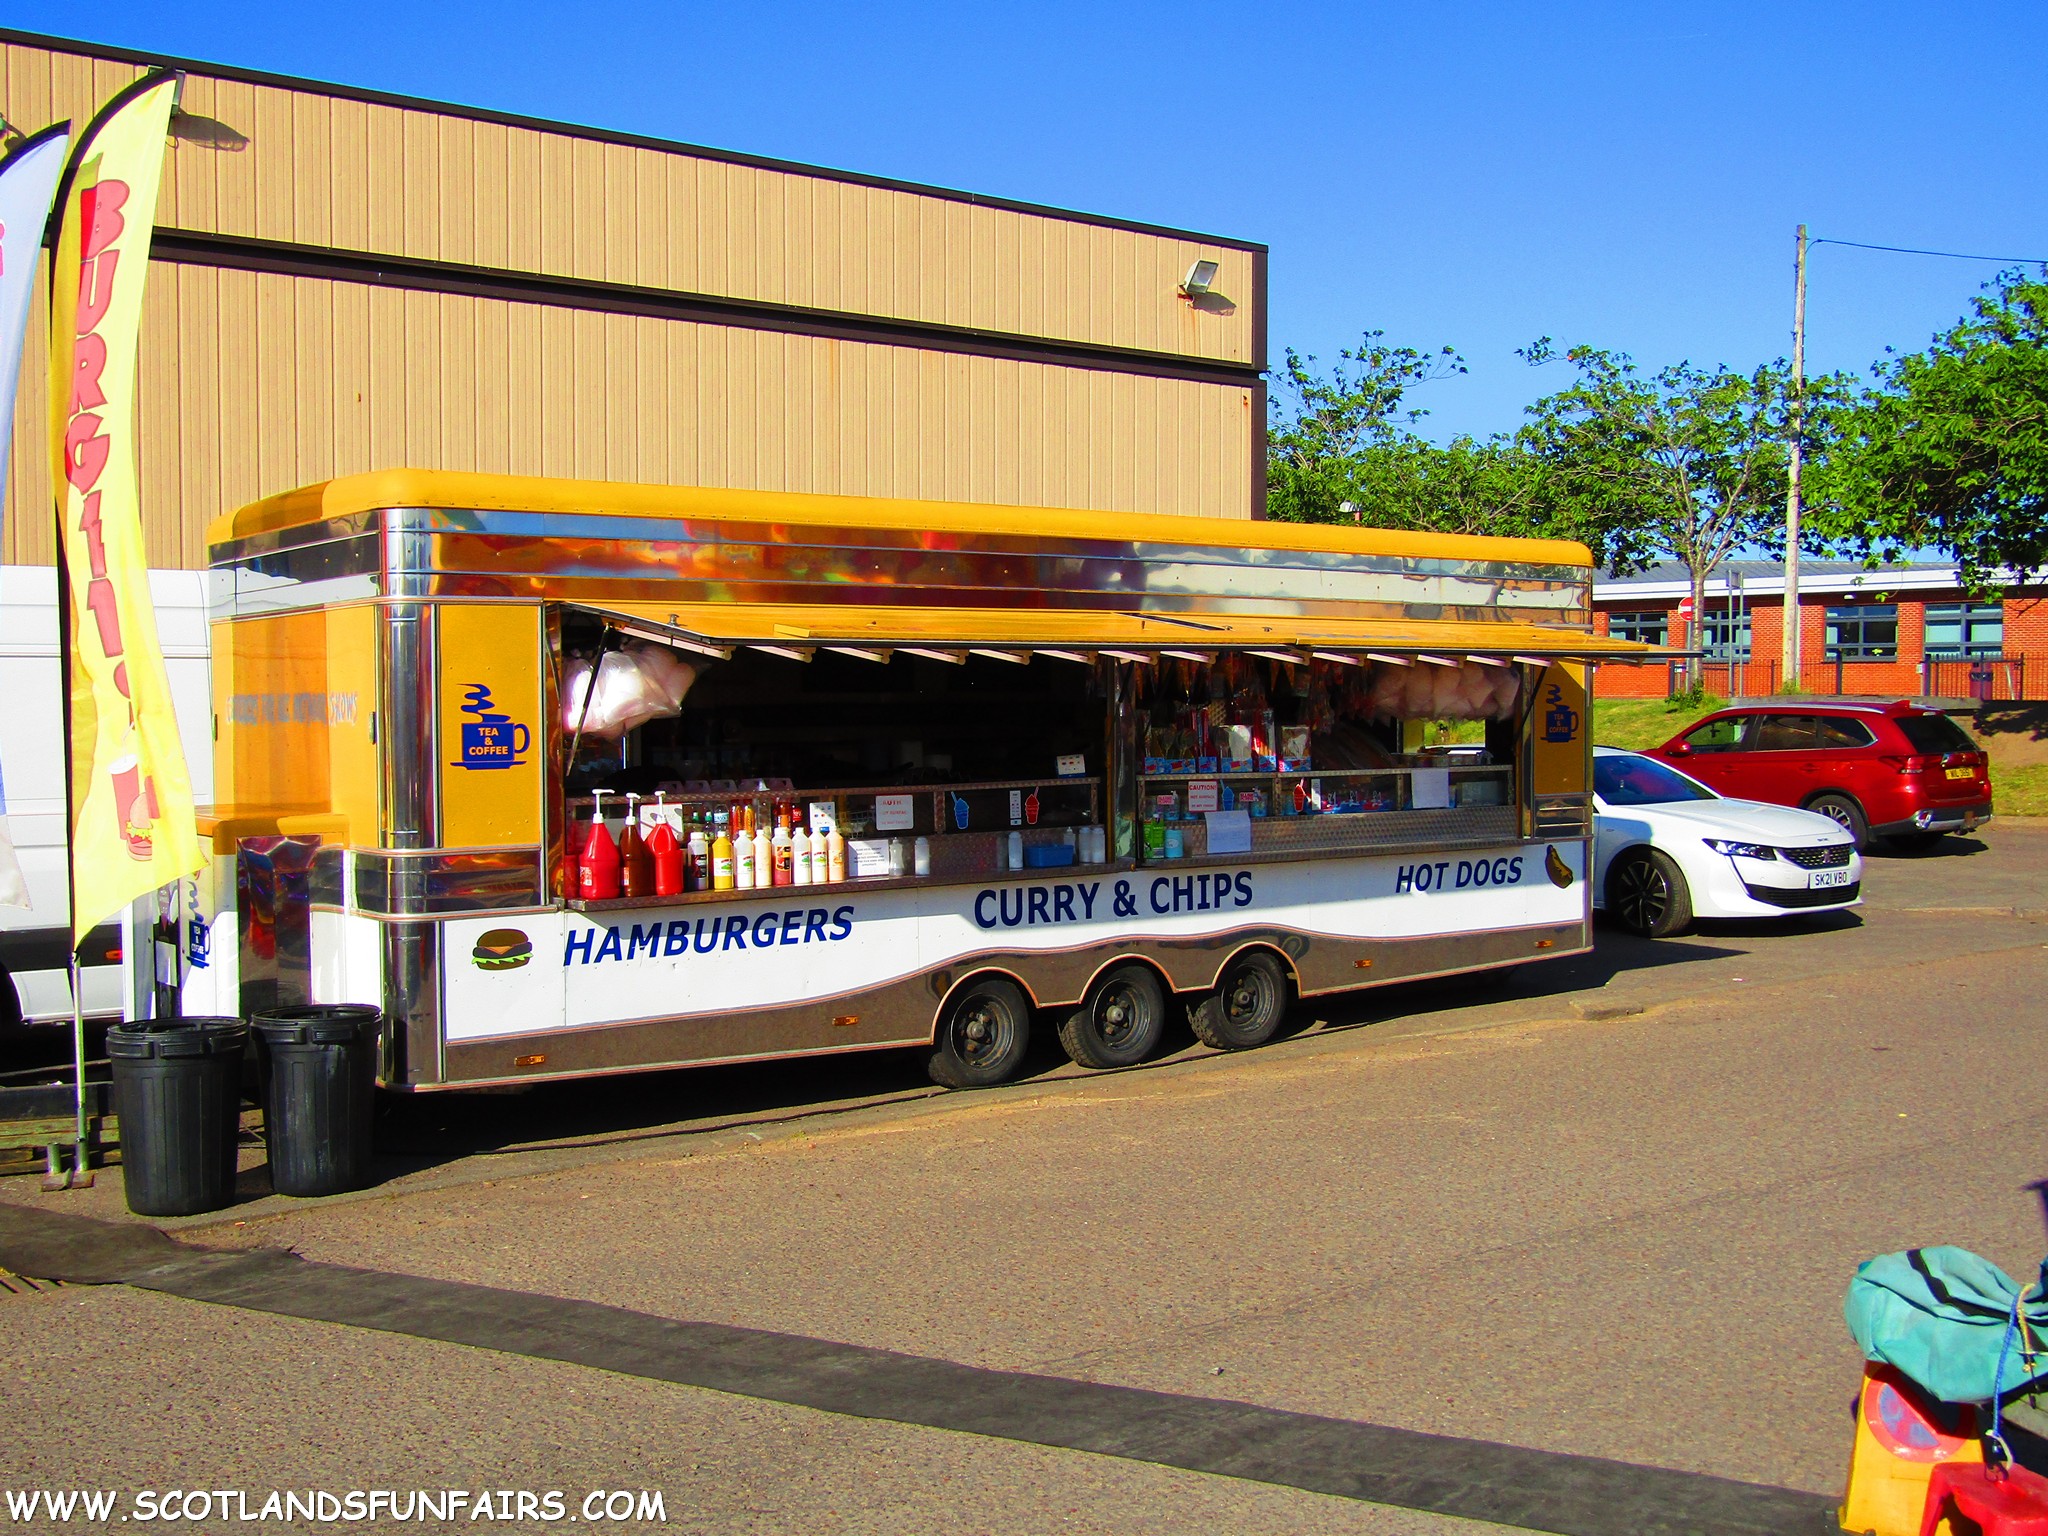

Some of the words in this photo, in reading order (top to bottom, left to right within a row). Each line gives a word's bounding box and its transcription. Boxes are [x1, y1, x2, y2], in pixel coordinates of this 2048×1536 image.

[478, 727, 499, 737] TEA
[484, 736, 493, 746] &
[468, 746, 509, 756] COFFEE
[1396, 861, 1451, 893] HOT
[1455, 857, 1524, 888] DOGS
[974, 882, 1101, 929] CURRY
[1113, 879, 1140, 917] &
[1150, 871, 1253, 914] CHIPS
[563, 906, 855, 966] HAMBURGERS
